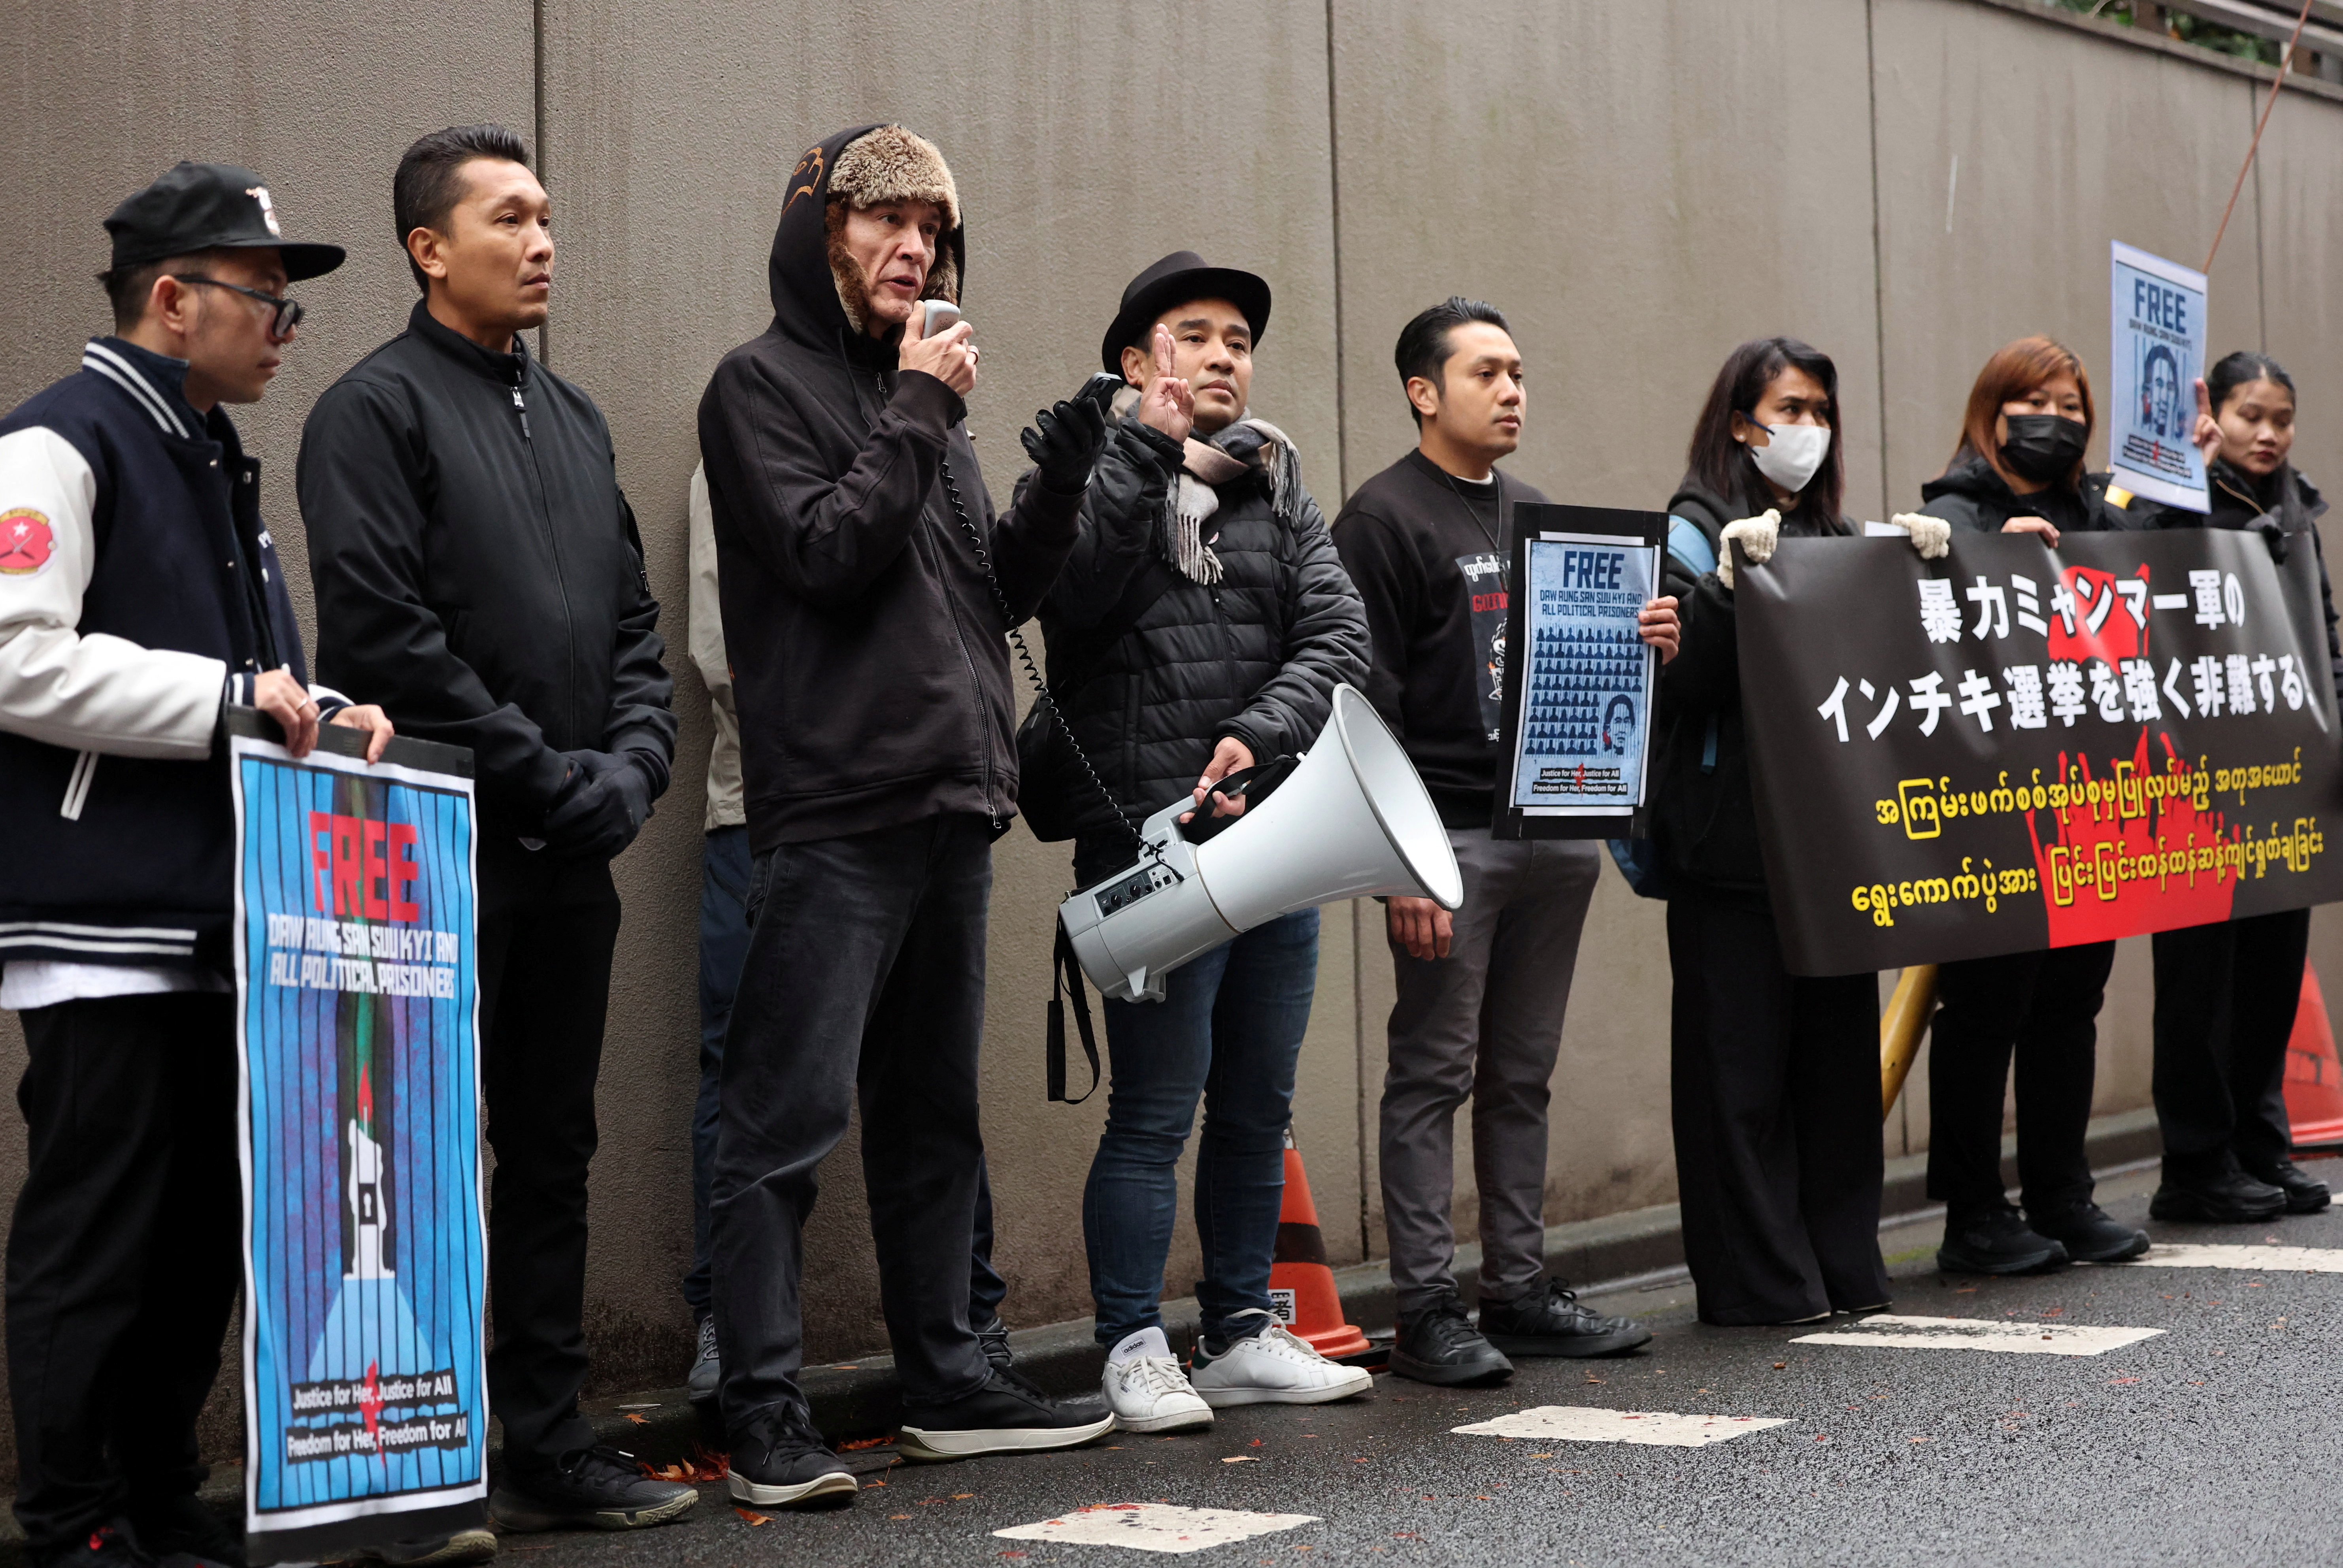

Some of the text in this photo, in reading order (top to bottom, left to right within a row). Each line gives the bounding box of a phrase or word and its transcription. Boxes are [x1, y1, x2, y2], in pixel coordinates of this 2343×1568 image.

[2135, 278, 2186, 334] FREE
[1563, 551, 1625, 590] FREE
[1540, 589, 1642, 606] DAW AUNG SAN SUU KYI AND
[1542, 603, 1640, 619] ALL POLITICAL PRISONERS
[1917, 569, 2246, 644] 暴力ミャンマー軍の
[1560, 784, 1568, 792] for
[1569, 784, 1581, 792] Her,
[1607, 785, 1617, 793] for
[1617, 785, 1627, 793] All
[308, 810, 419, 922] FREE
[268, 912, 305, 949] DAW
[341, 922, 371, 957] SAN
[370, 925, 399, 959] SUU
[399, 929, 433, 962] KYI
[436, 931, 458, 964] AND
[270, 952, 455, 999] ALL POLITICAL PRISONERS
[1124, 1341, 1144, 1353] adidas
[293, 1374, 453, 1410] Justice for Her, Justice for All
[333, 1429, 351, 1452] for
[378, 1423, 428, 1447] Freedom
[430, 1420, 452, 1441] for
